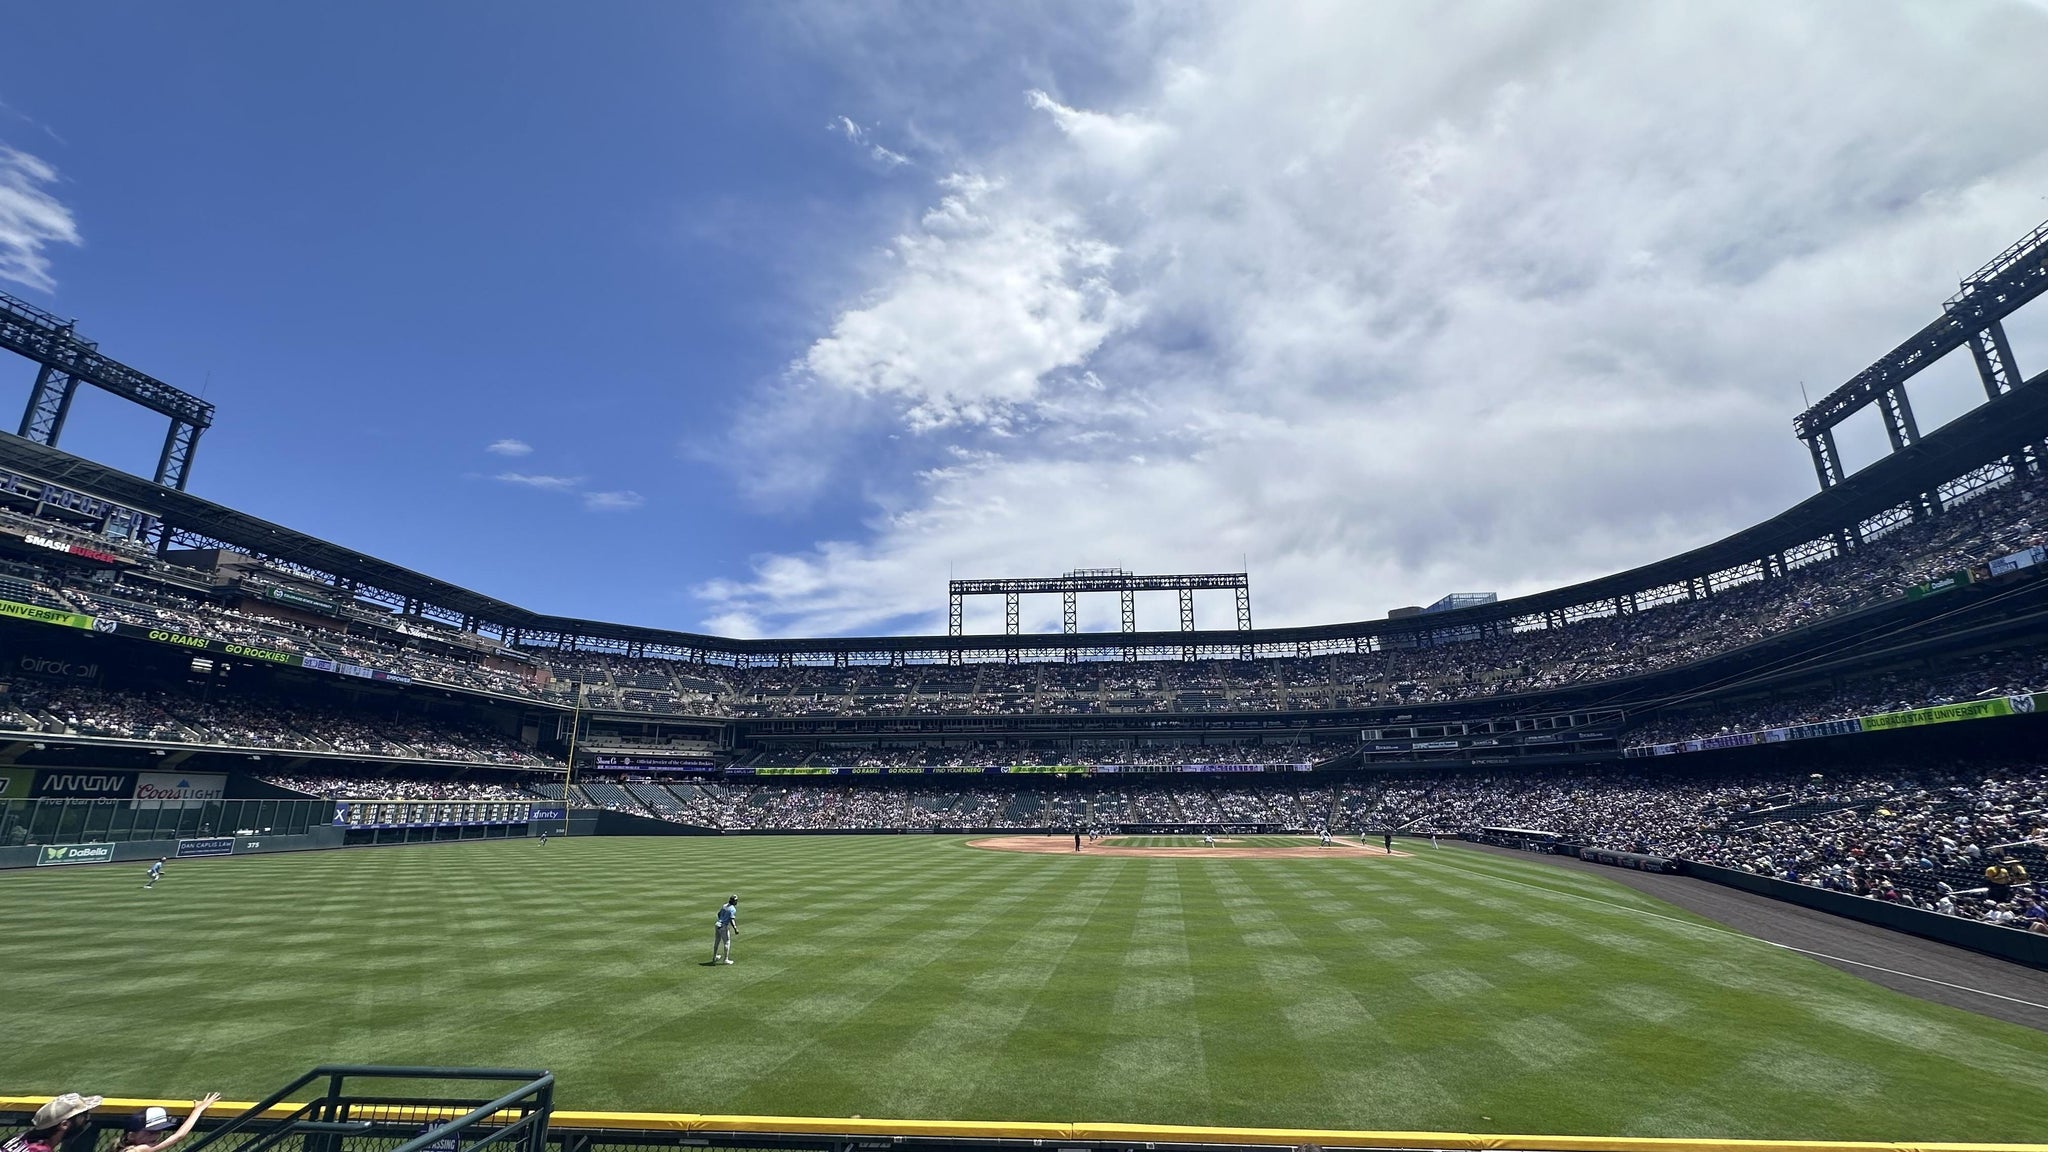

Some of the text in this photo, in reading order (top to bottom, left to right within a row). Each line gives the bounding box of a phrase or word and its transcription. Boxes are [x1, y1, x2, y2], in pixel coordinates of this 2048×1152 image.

[41, 484, 157, 531] ROOFTOP
[25, 534, 116, 563] SMASHBURGER
[0, 603, 71, 622] UNIVERSITY
[149, 630, 209, 648] GO RAMS!
[225, 644, 290, 663] GO ROCKIES!
[1866, 716, 1908, 729] COLORADO
[1908, 711, 1934, 724] STATE
[1935, 704, 1989, 720] UNIVERSITY
[42, 775, 126, 792] ARROW
[137, 783, 222, 800] Coors LIGHT
[334, 808, 345, 822] X
[533, 809, 559, 819] xfinity
[68, 847, 108, 857] DaBella
